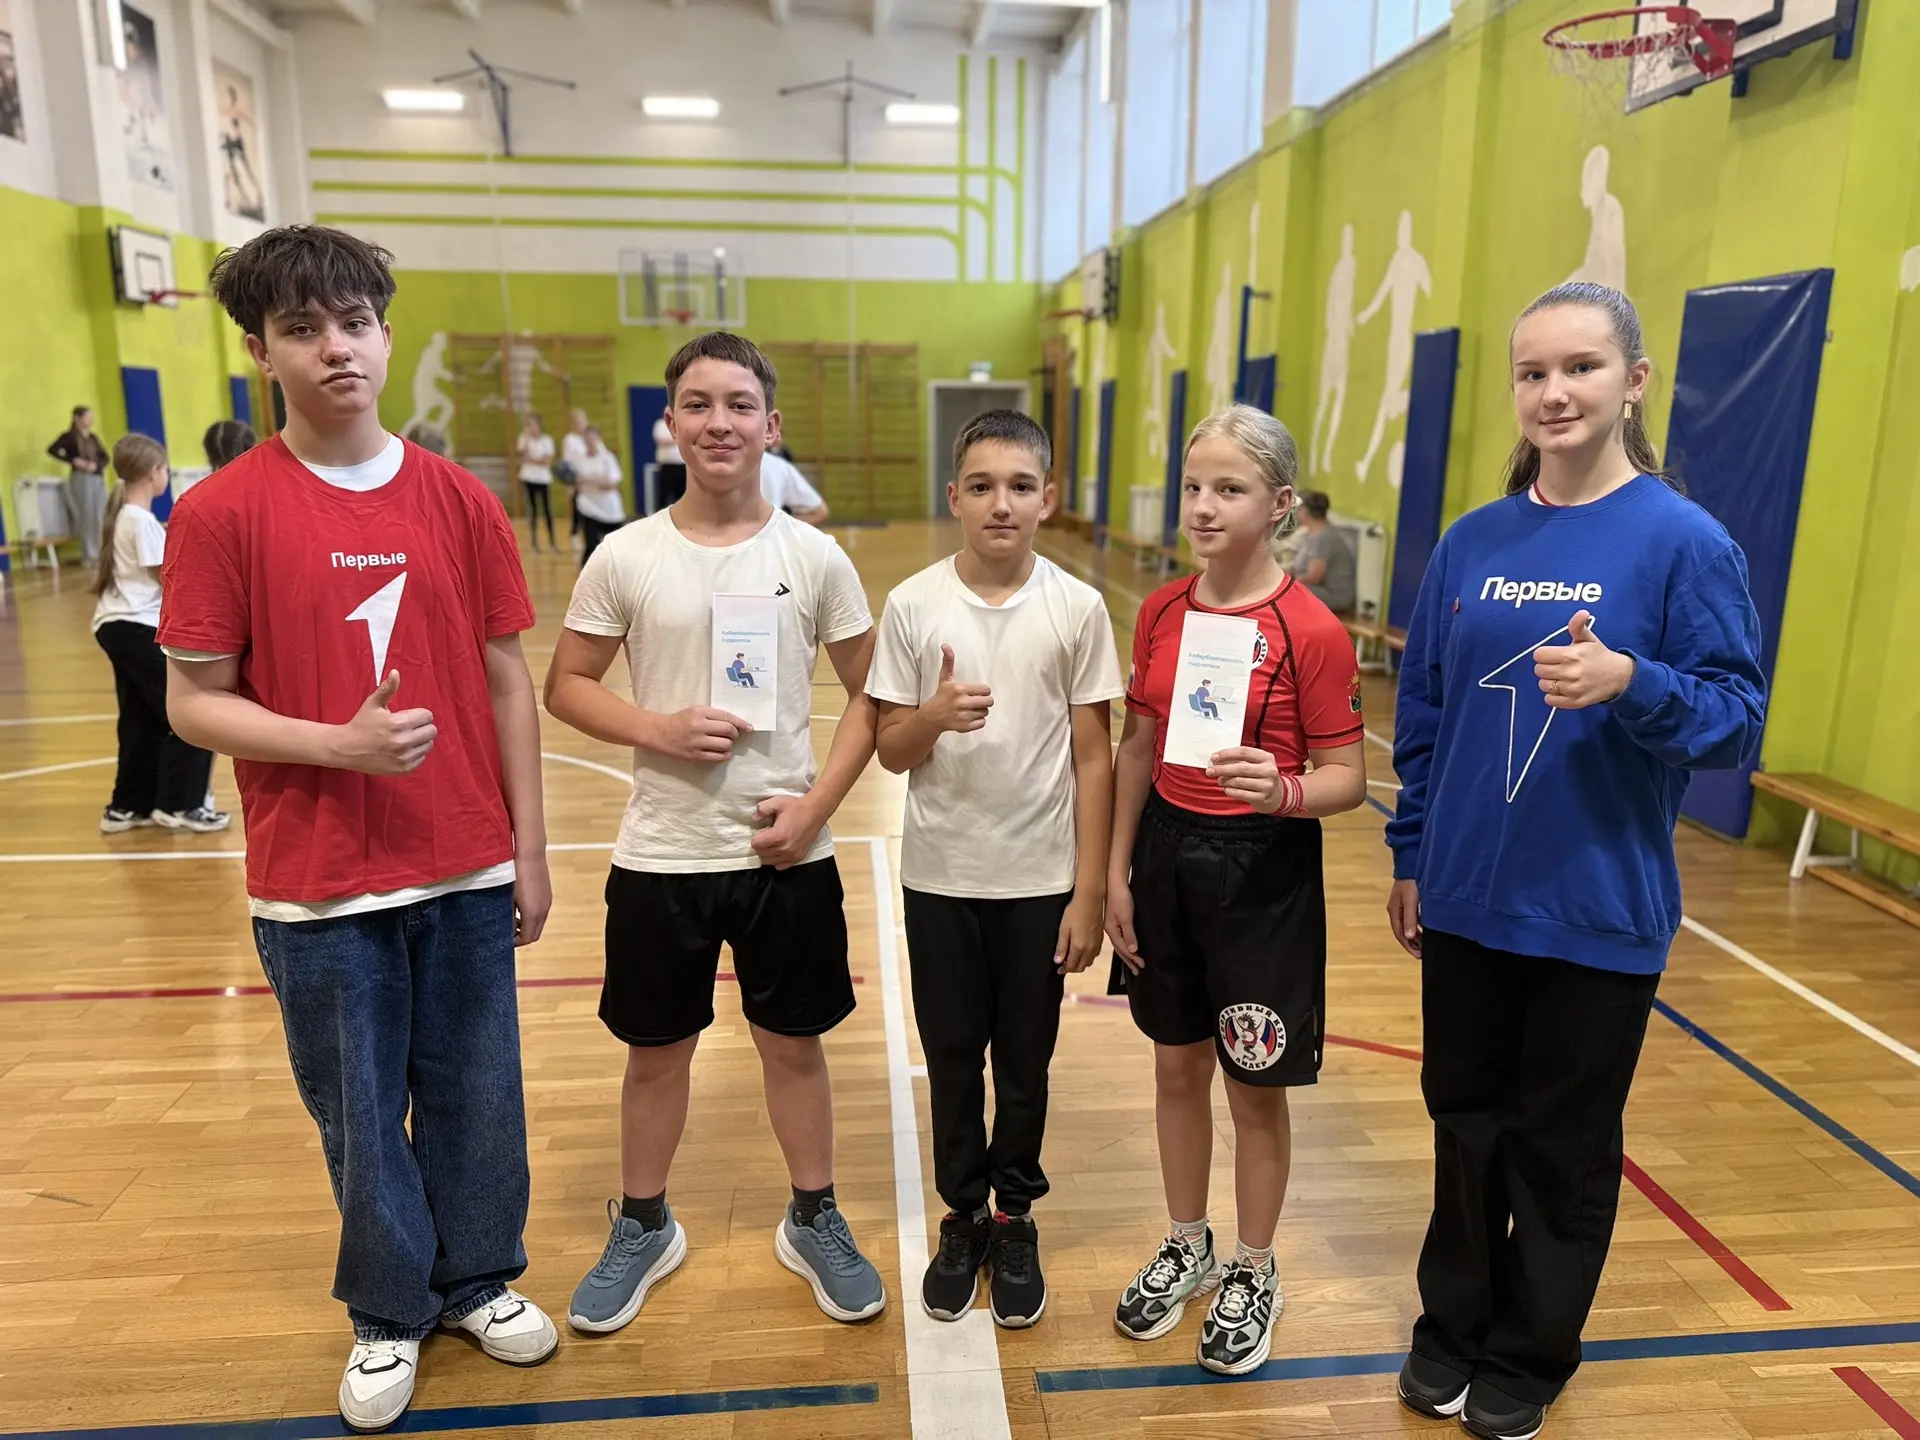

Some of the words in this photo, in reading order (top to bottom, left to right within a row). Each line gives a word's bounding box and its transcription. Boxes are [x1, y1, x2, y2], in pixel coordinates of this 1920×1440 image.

[331, 551, 407, 571] Первые
[1479, 576, 1603, 608] Первые
[1272, 1018, 1284, 1049] КЛУБ
[1235, 1057, 1268, 1070] ЛИДЕР
